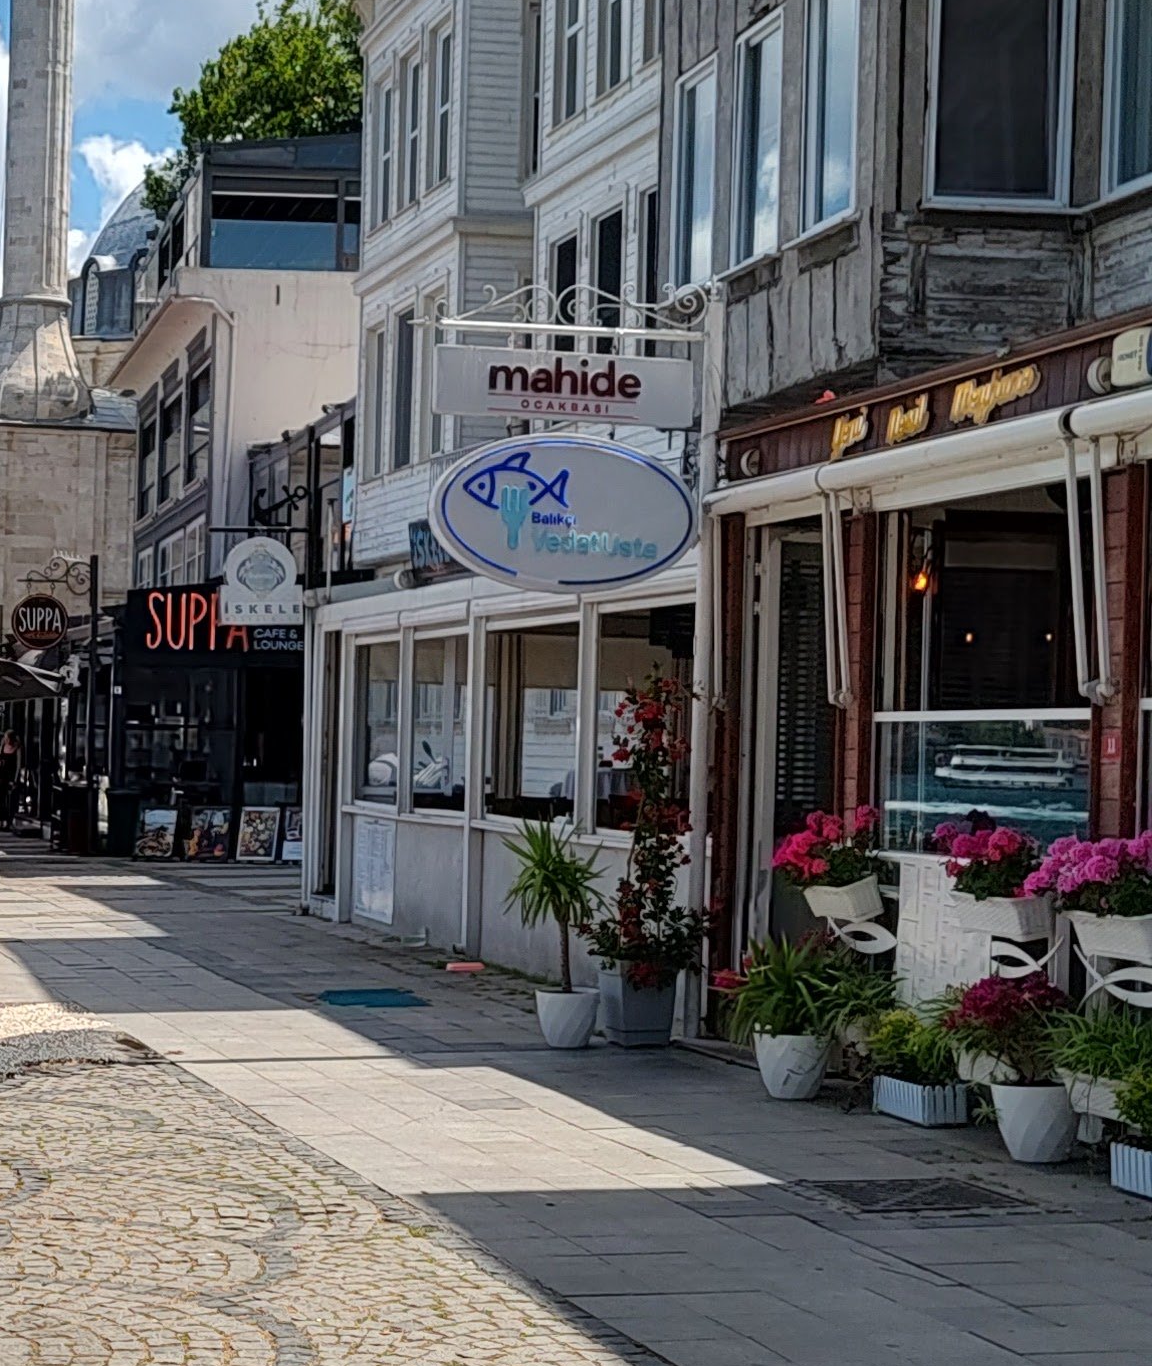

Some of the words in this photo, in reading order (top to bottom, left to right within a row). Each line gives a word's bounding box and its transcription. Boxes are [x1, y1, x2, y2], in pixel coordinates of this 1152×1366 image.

[489, 357, 641, 398] mahide
[531, 511, 576, 528] Balıkçı
[224, 601, 300, 614] İSKELE
[18, 607, 62, 633] SUPPA
[253, 628, 286, 639] CAFE
[289, 629, 298, 639] &
[253, 640, 304, 650] LOUNGE
